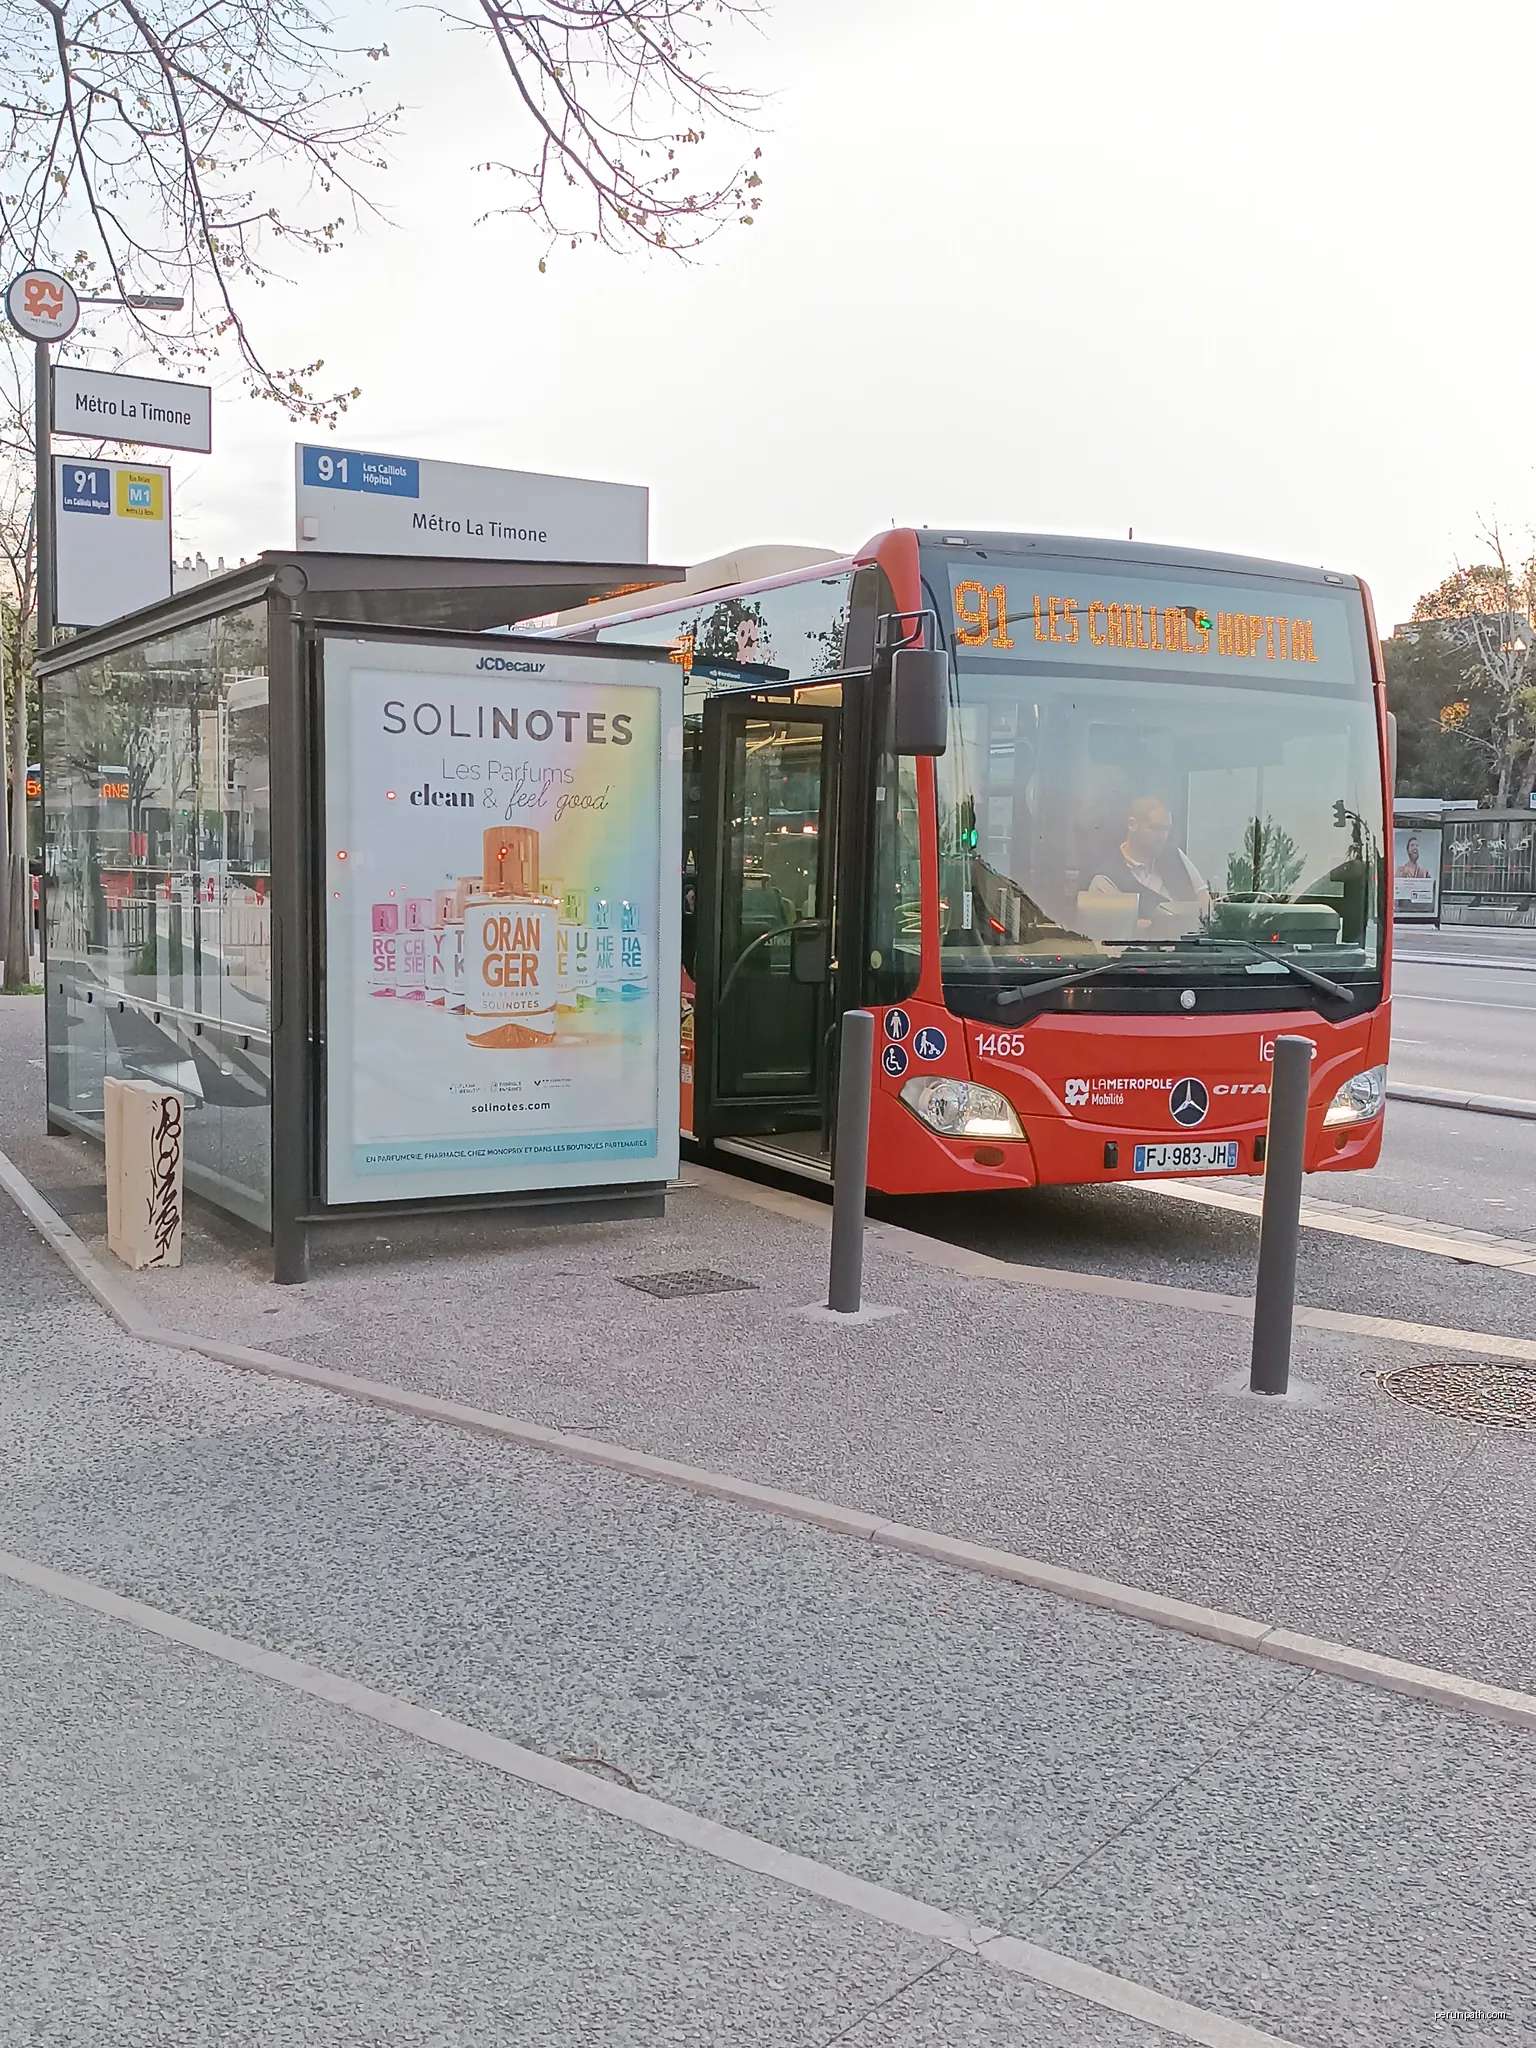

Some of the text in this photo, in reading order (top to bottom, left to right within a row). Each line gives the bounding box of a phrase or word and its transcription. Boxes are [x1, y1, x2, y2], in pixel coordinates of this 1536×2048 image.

[75, 393, 191, 425] Métro La Timone
[318, 455, 348, 483] 91
[362, 462, 407, 476] Les Caillols
[362, 473, 392, 486] Hôpital
[74, 470, 97, 494] 91
[130, 488, 150, 502] M1
[412, 512, 548, 543] Métro La Timone
[954, 578, 1321, 663] 91 LES CAILLOLS HOPITAL
[382, 700, 634, 746] SOLINOTES
[442, 758, 575, 784] Les Parfums
[410, 778, 611, 822] clean & feel good
[482, 916, 540, 952] ORAN
[482, 953, 539, 988] GER
[482, 999, 540, 1010] SOLINOTES
[975, 1033, 1025, 1057] 1465
[1091, 1092, 1124, 1106] Mobilité
[1212, 1083, 1272, 1095] CITA
[471, 1101, 551, 1113] solinotes.com
